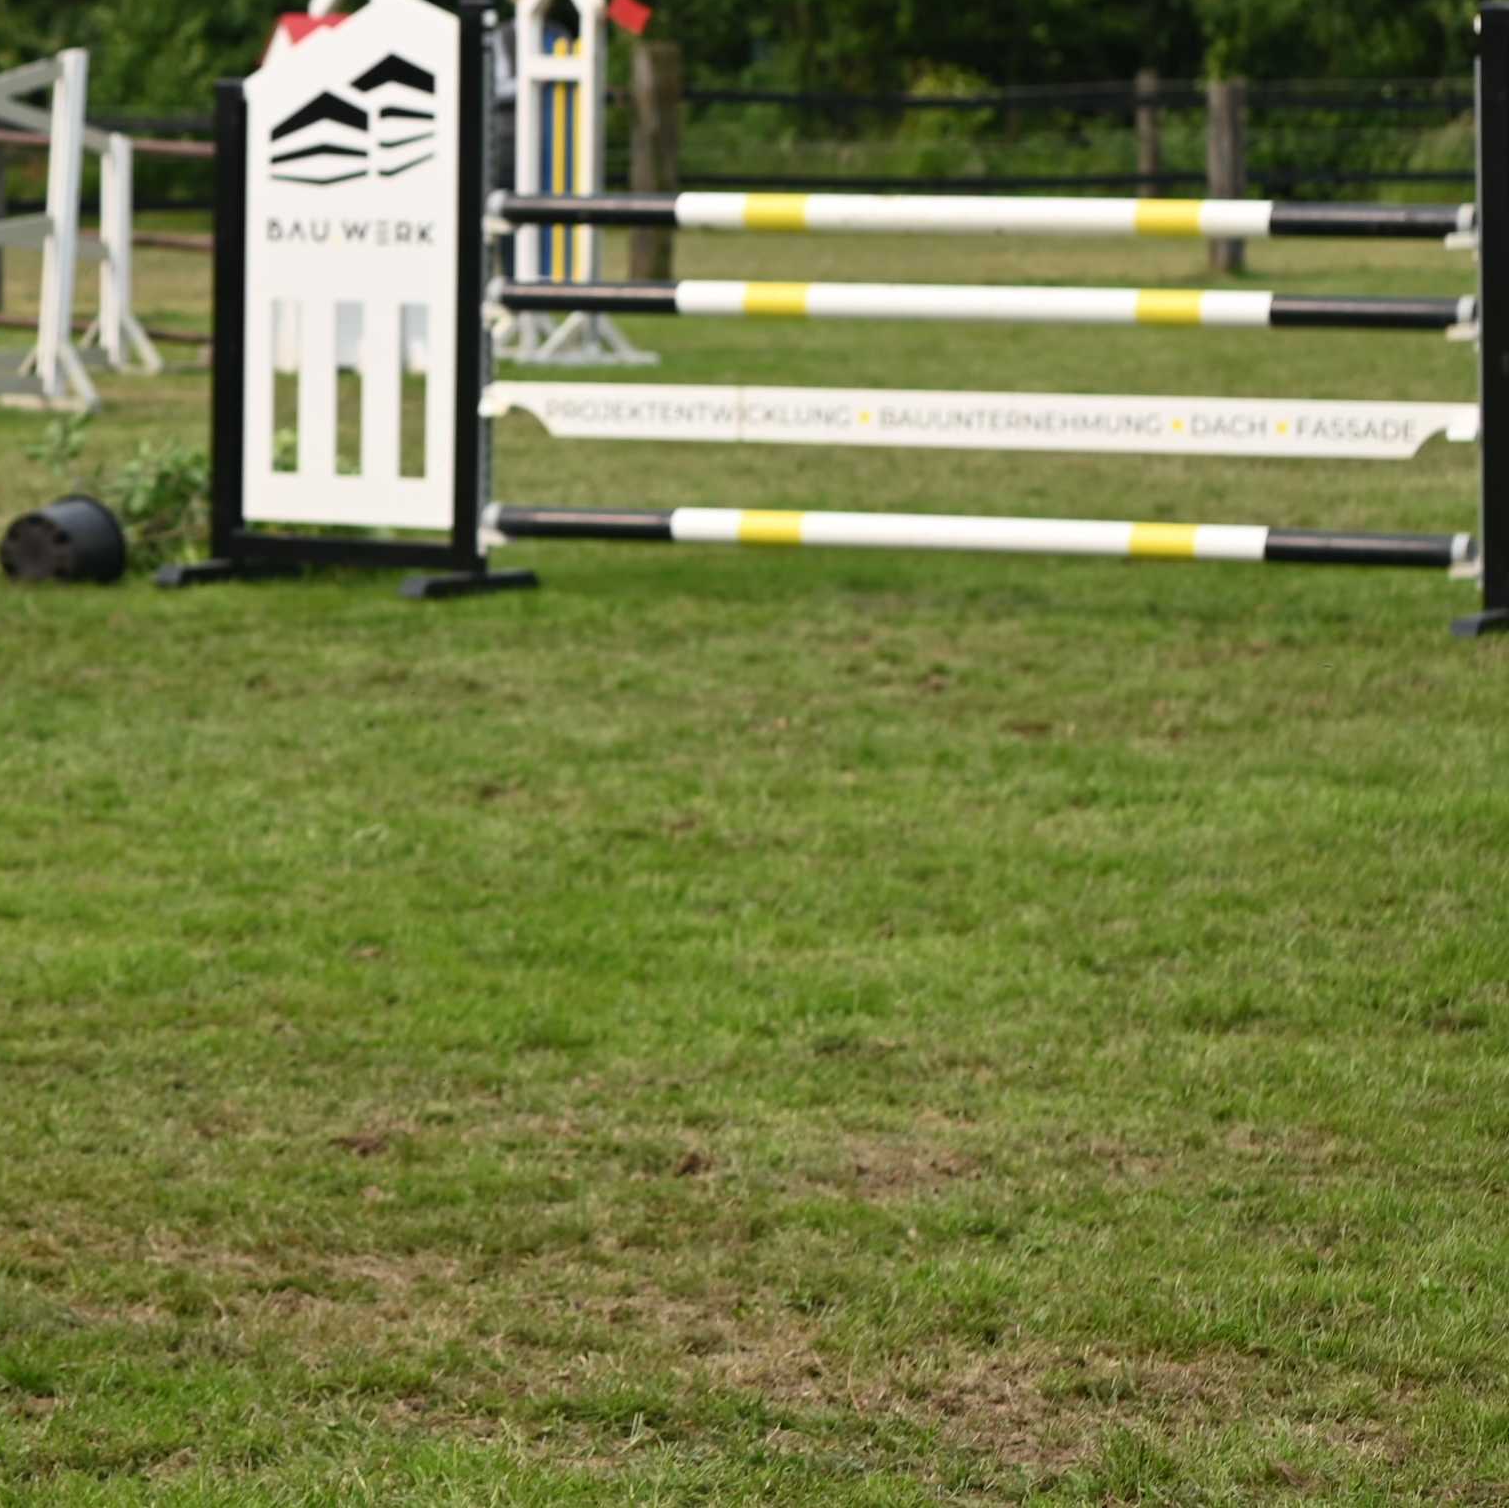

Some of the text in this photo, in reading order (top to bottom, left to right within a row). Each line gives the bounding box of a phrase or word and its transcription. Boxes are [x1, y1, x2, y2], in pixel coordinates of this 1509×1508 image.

[266, 217, 435, 246] BAU WERK
[545, 398, 1416, 441] PROJEKTENTWICKLUNG BAUUNTERNEHMUNG DACH FASSADE
